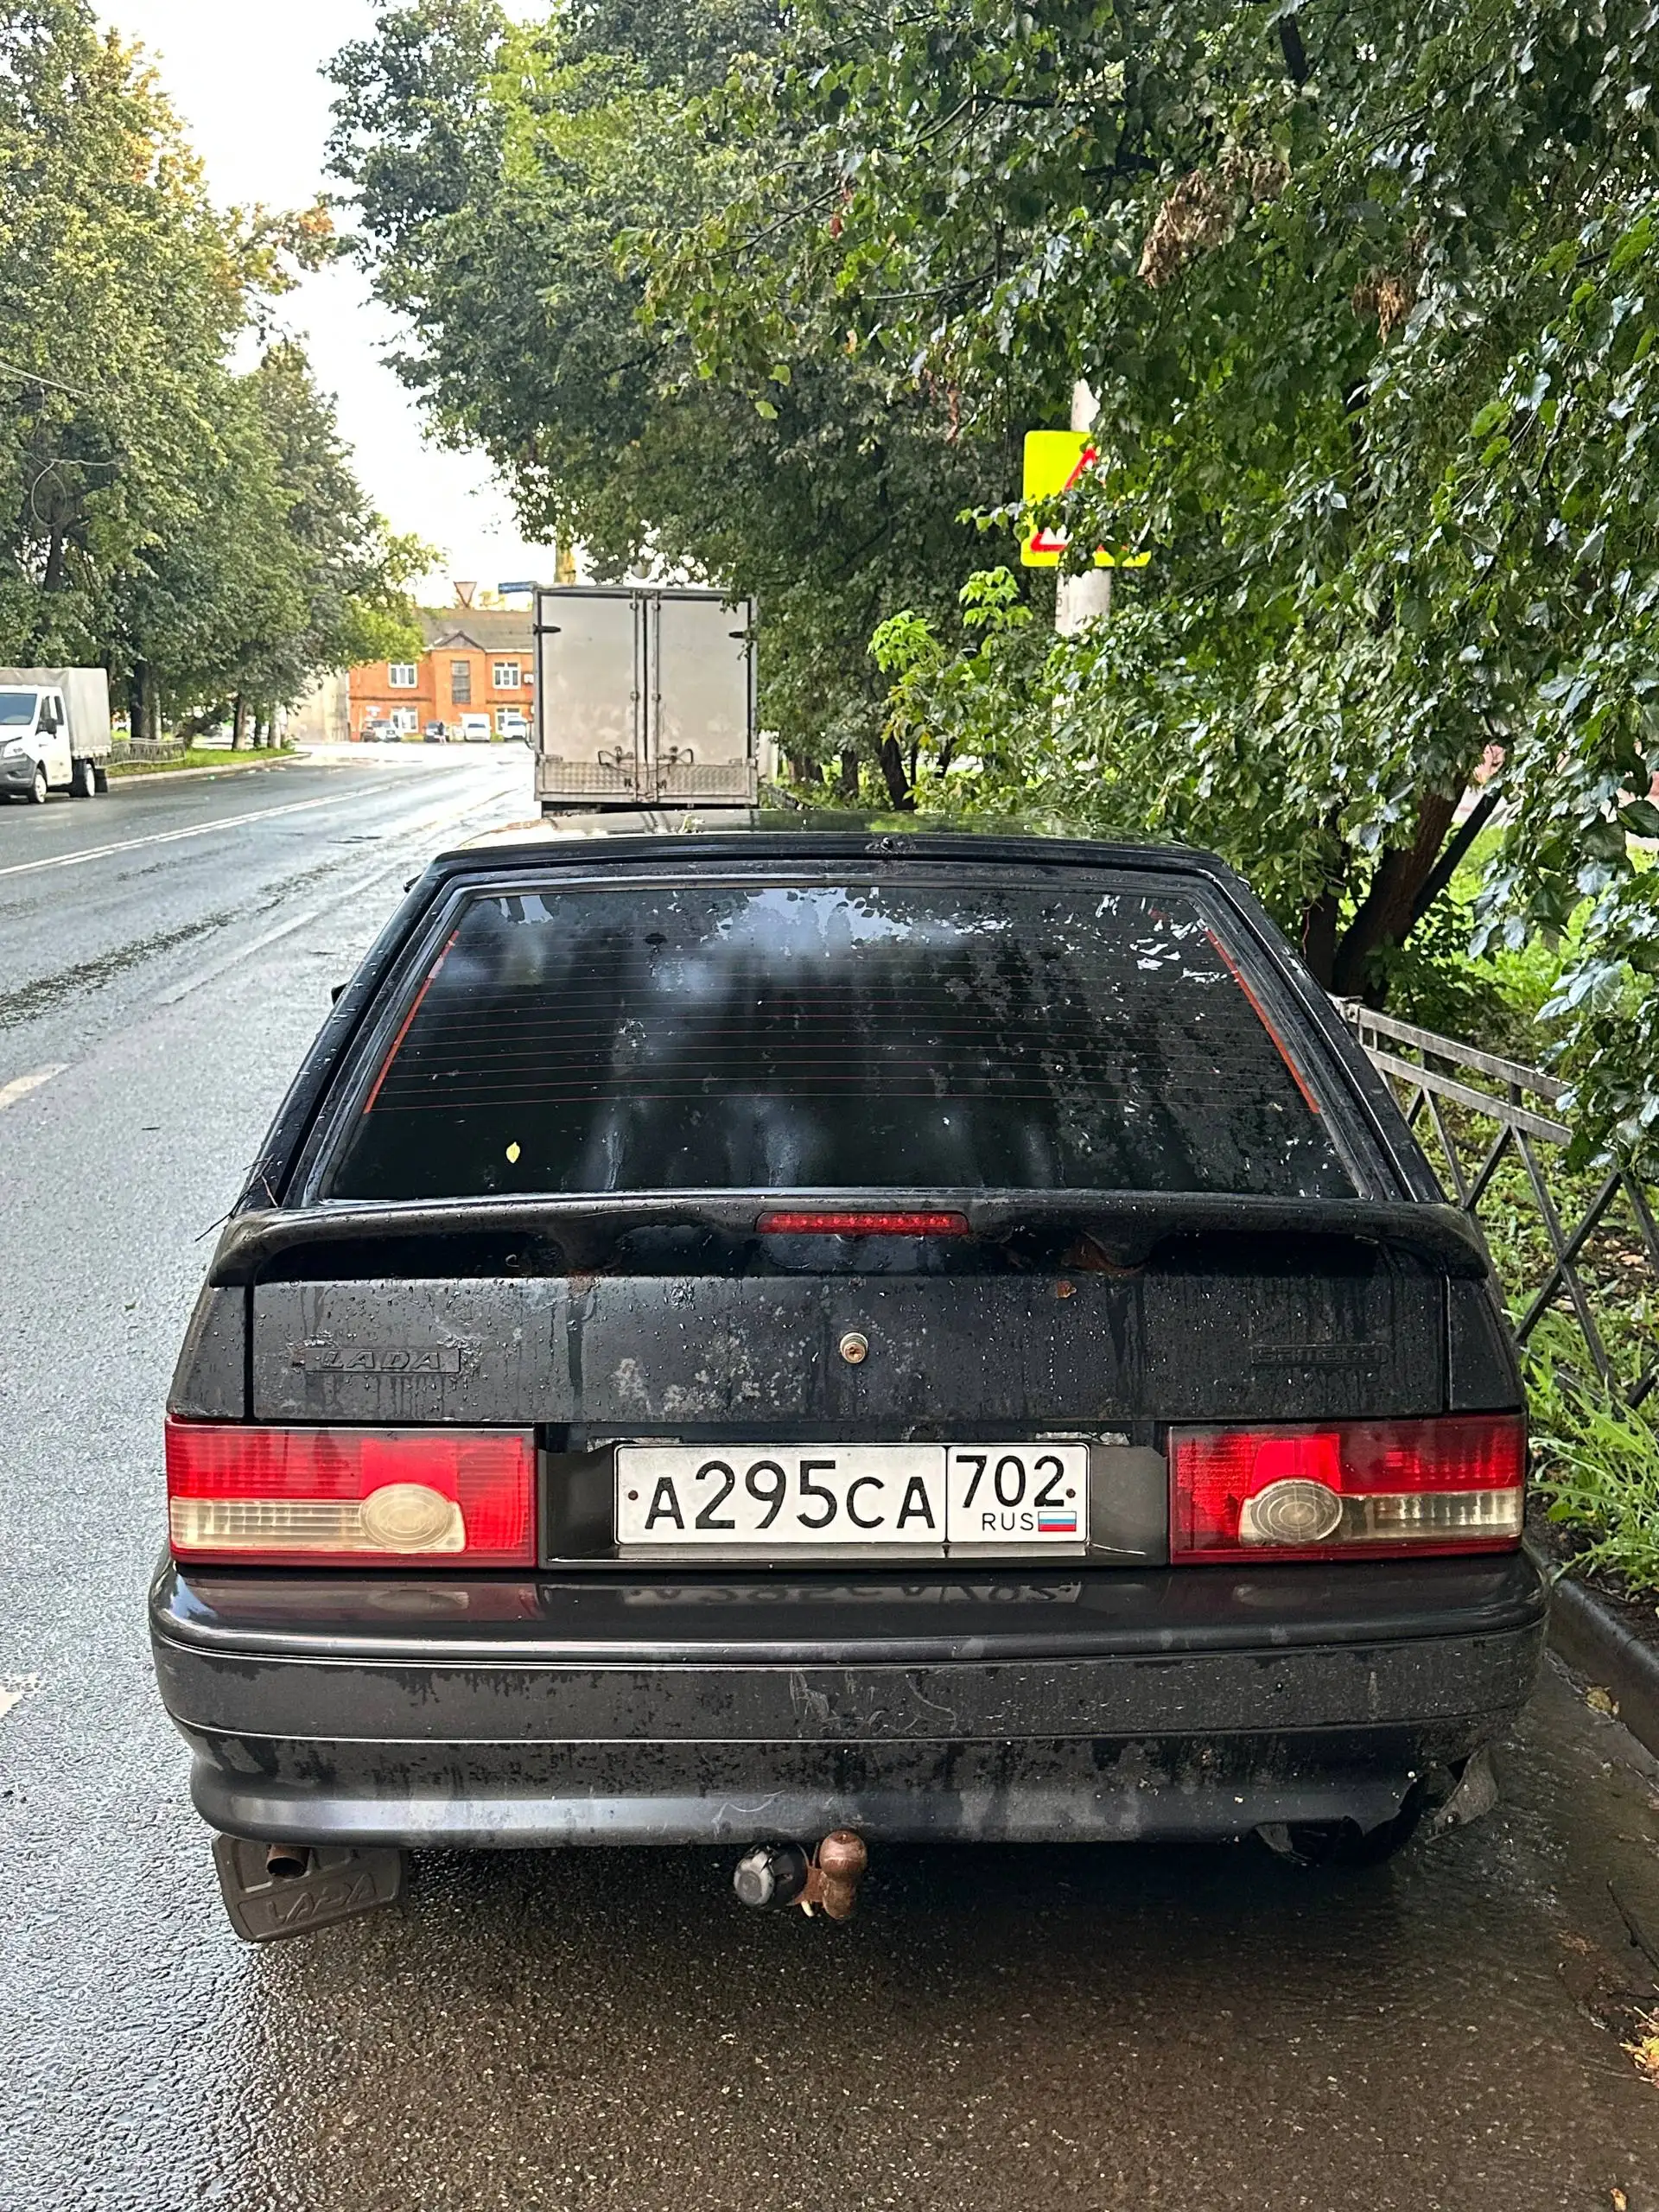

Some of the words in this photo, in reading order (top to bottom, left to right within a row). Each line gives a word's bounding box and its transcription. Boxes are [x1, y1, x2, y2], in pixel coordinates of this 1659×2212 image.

[319, 1350, 441, 1370] LADA
[644, 1459, 937, 1529] A295CA
[956, 1454, 1065, 1508] 702
[982, 1511, 1034, 1531] RUS
[268, 1871, 378, 1925] LADA
